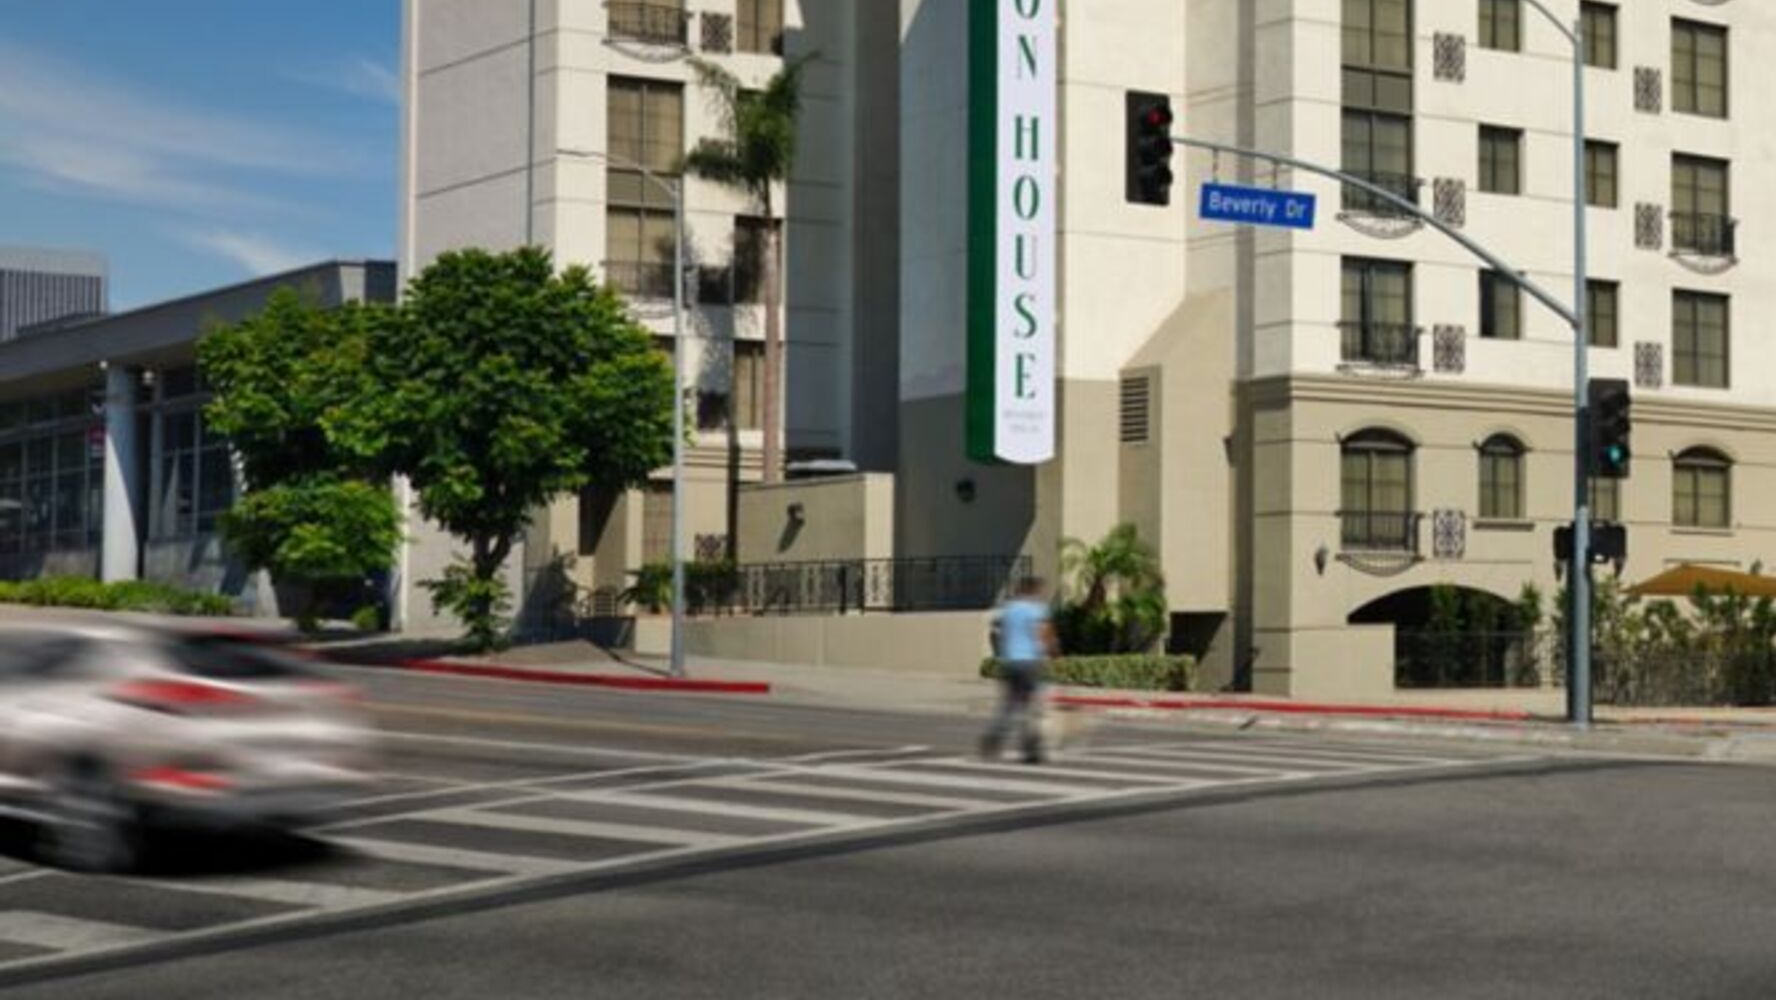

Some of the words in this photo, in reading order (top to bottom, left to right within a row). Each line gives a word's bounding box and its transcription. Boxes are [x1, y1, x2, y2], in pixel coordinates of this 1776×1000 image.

[1013, 115, 1040, 398] HOUSE
[1209, 191, 1277, 219] Beverly
[1286, 198, 1308, 219] Dr
